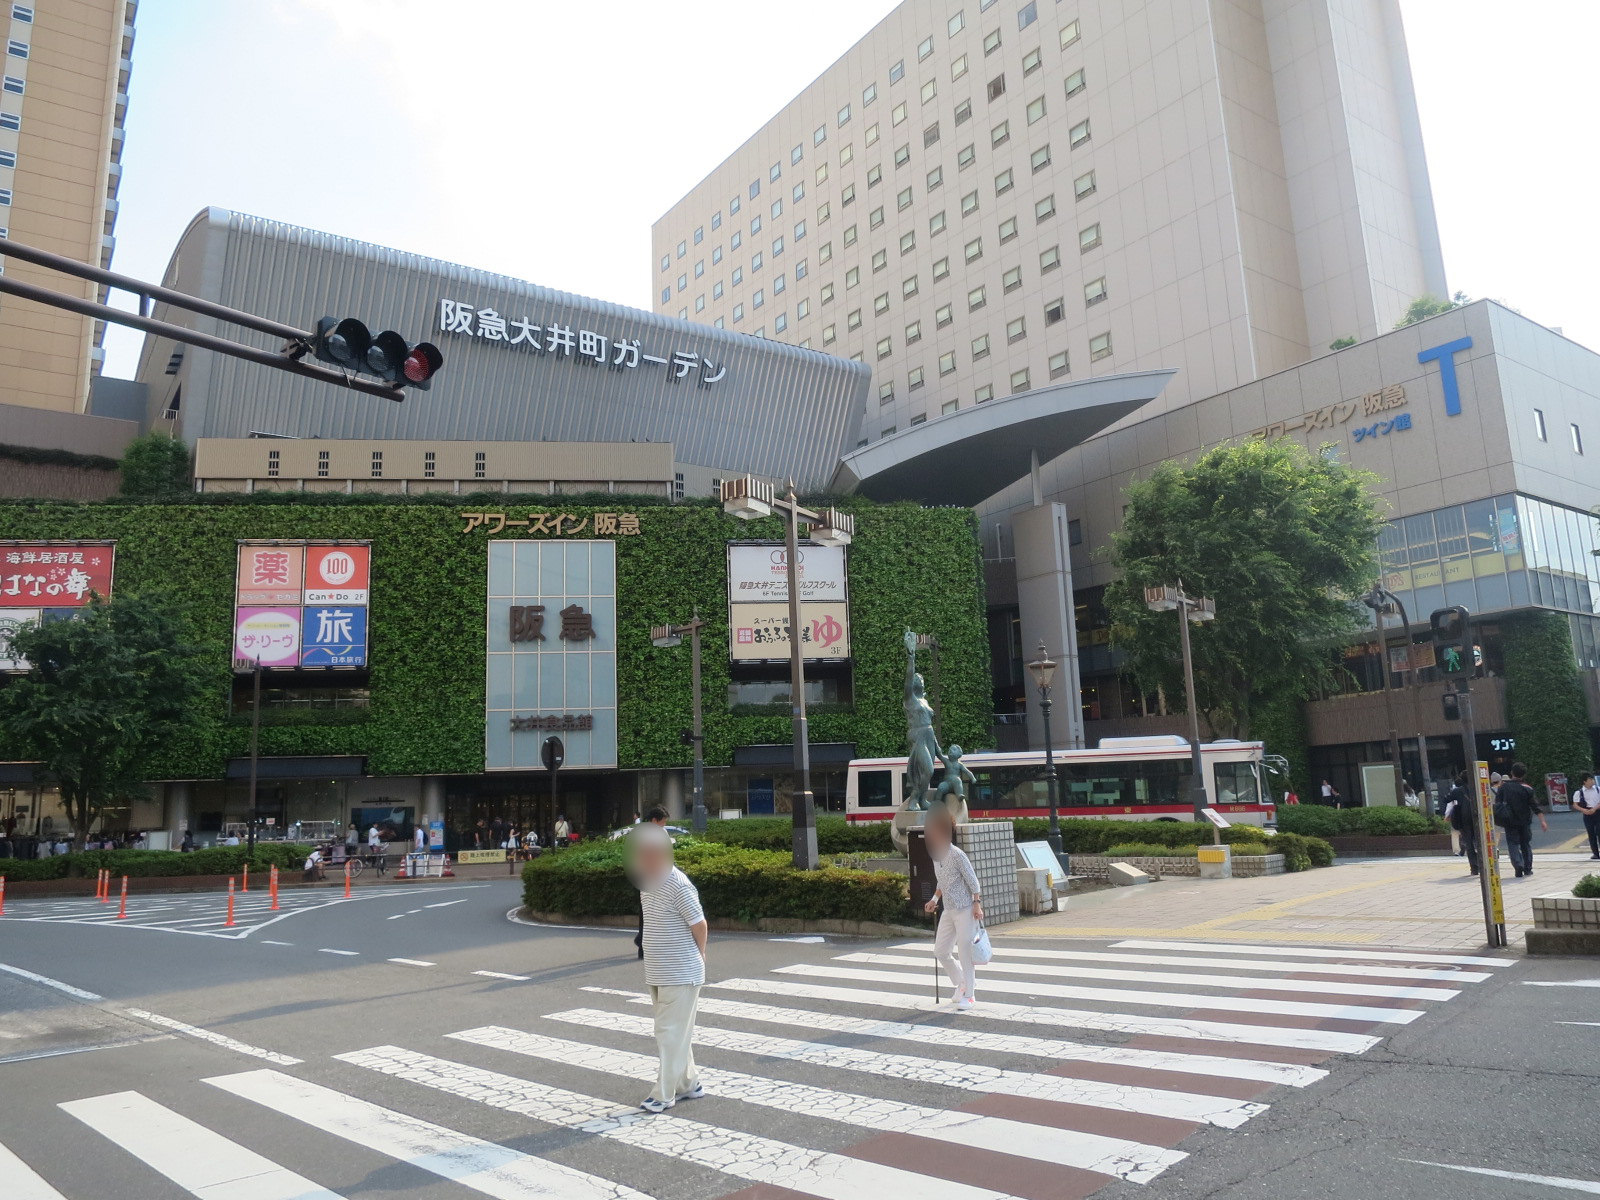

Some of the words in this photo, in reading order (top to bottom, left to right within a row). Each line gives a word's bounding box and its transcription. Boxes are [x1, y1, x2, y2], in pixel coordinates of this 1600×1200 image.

[440, 298, 726, 383] 阪急大井町ガーデン
[1417, 335, 1473, 417] T
[1361, 383, 1409, 418] 阪急
[1352, 412, 1412, 443] ツイン館
[461, 512, 588, 536] アワーズイン
[594, 512, 641, 536] 阪急
[6, 551, 85, 565] 海鮮居酒屋
[253, 551, 290, 585] 薬
[326, 557, 348, 575] 100
[739, 580, 837, 590] 阪急大井テニスルフスクール
[1414, 566, 1460, 580] RESTAUANT
[308, 593, 327, 601] Can
[336, 593, 349, 601] Do
[316, 609, 354, 643] 旅
[509, 604, 597, 642] 阪急
[811, 614, 843, 648] ゆ
[331, 656, 362, 664] 日本旅行
[830, 646, 842, 655] 3F
[509, 713, 594, 732] 大井食品館
